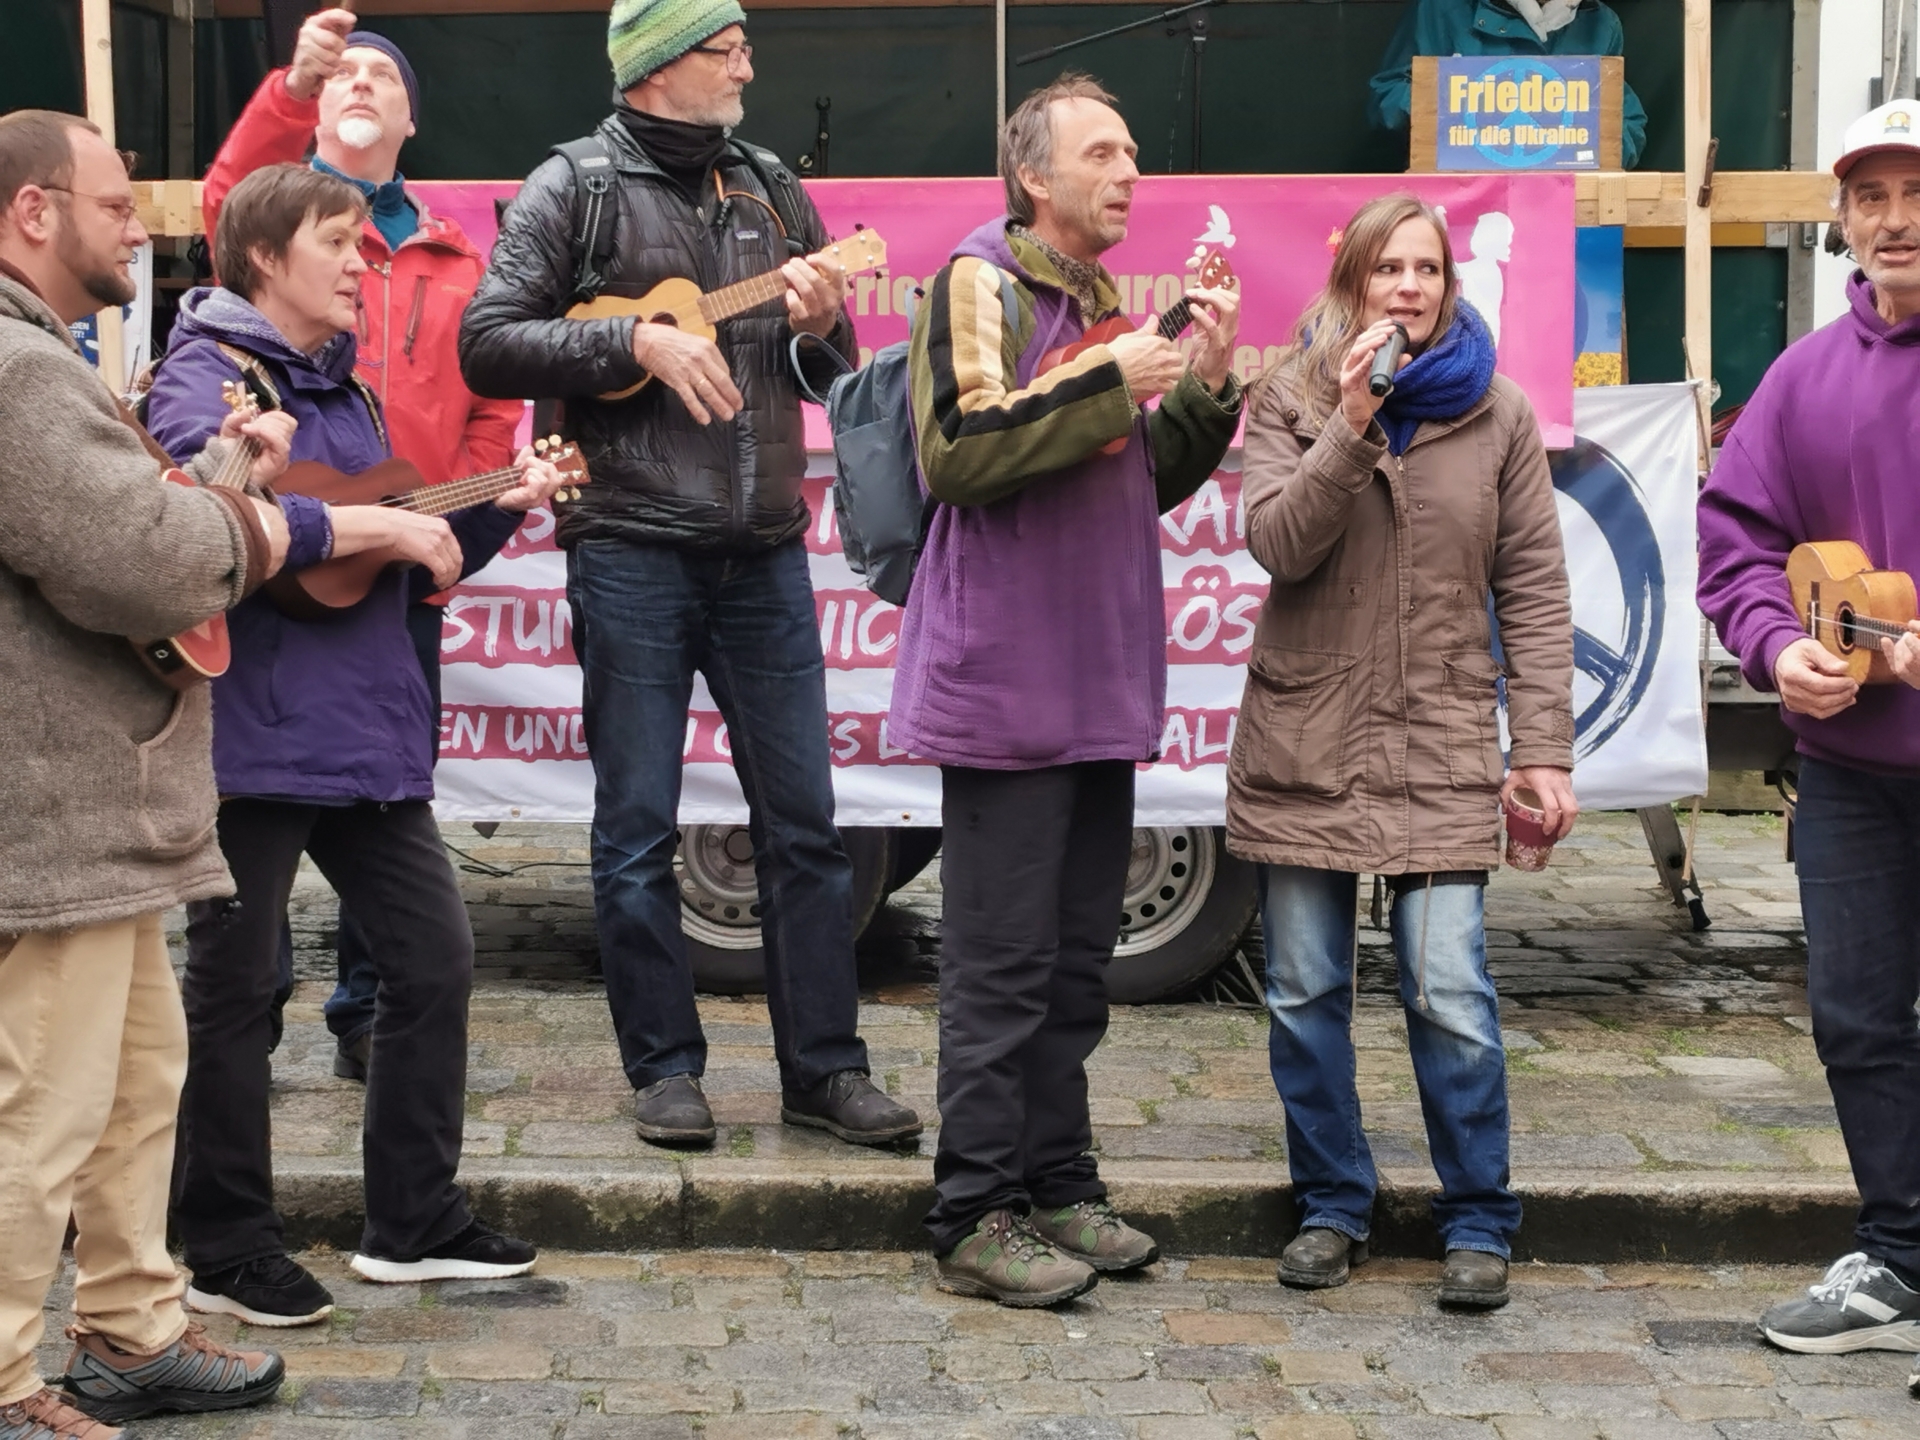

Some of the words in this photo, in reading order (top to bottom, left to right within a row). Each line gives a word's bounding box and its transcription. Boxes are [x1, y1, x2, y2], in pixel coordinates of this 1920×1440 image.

[1449, 74, 1590, 113] Frieden
[1449, 125, 1477, 146] für
[1480, 126, 1511, 146] die
[1514, 126, 1589, 145] Ukraine
